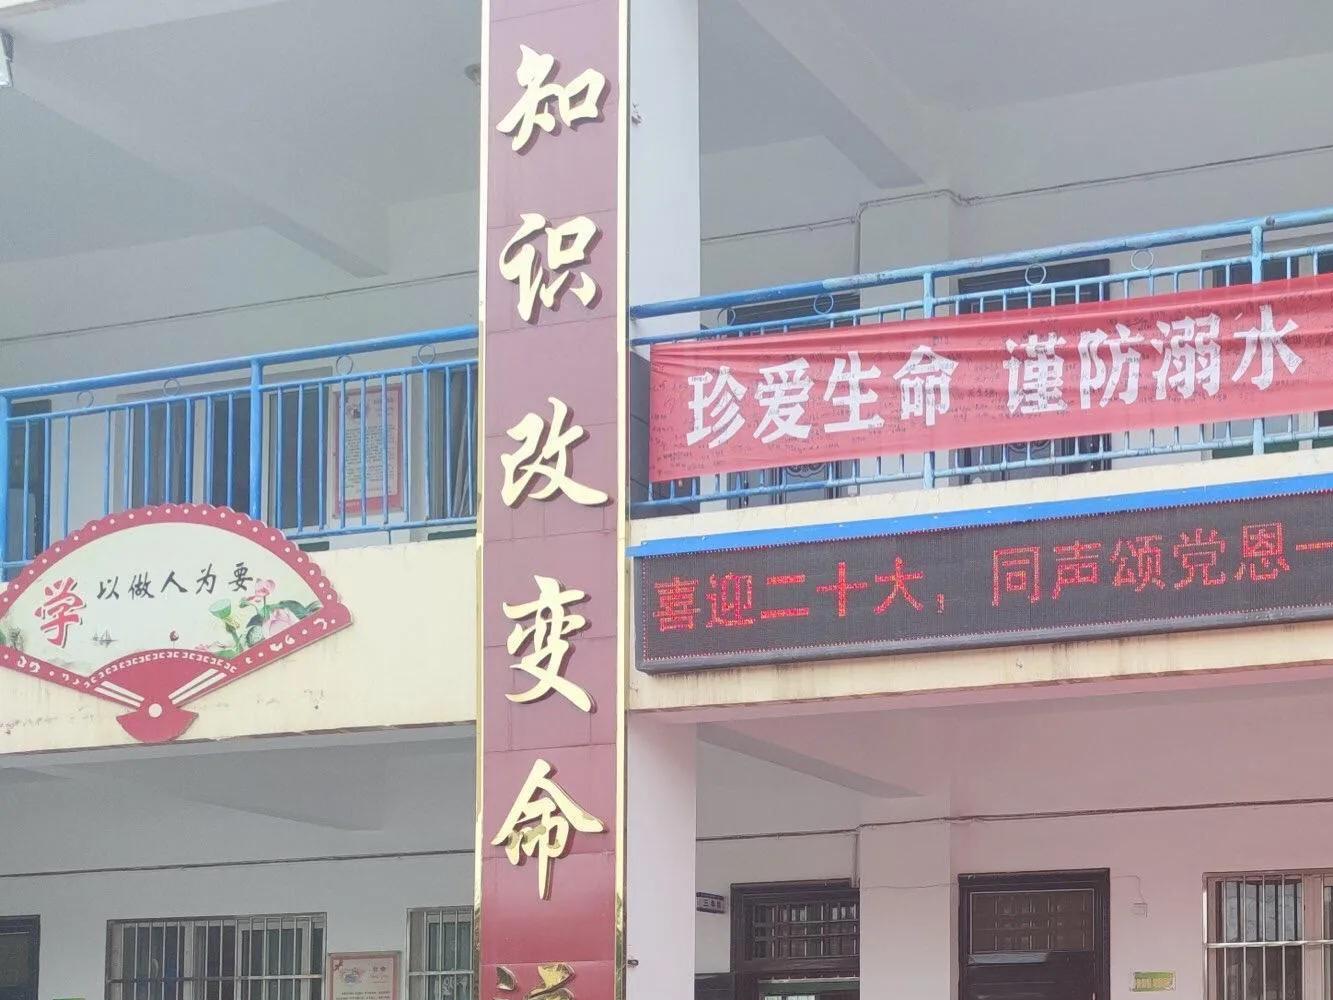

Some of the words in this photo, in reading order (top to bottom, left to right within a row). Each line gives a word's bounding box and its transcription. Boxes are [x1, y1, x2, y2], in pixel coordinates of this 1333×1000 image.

[686, 344, 960, 449] 珍爱生命
[1002, 304, 1304, 416] 谨防溺水
[34, 562, 255, 648] 学以做人为要
